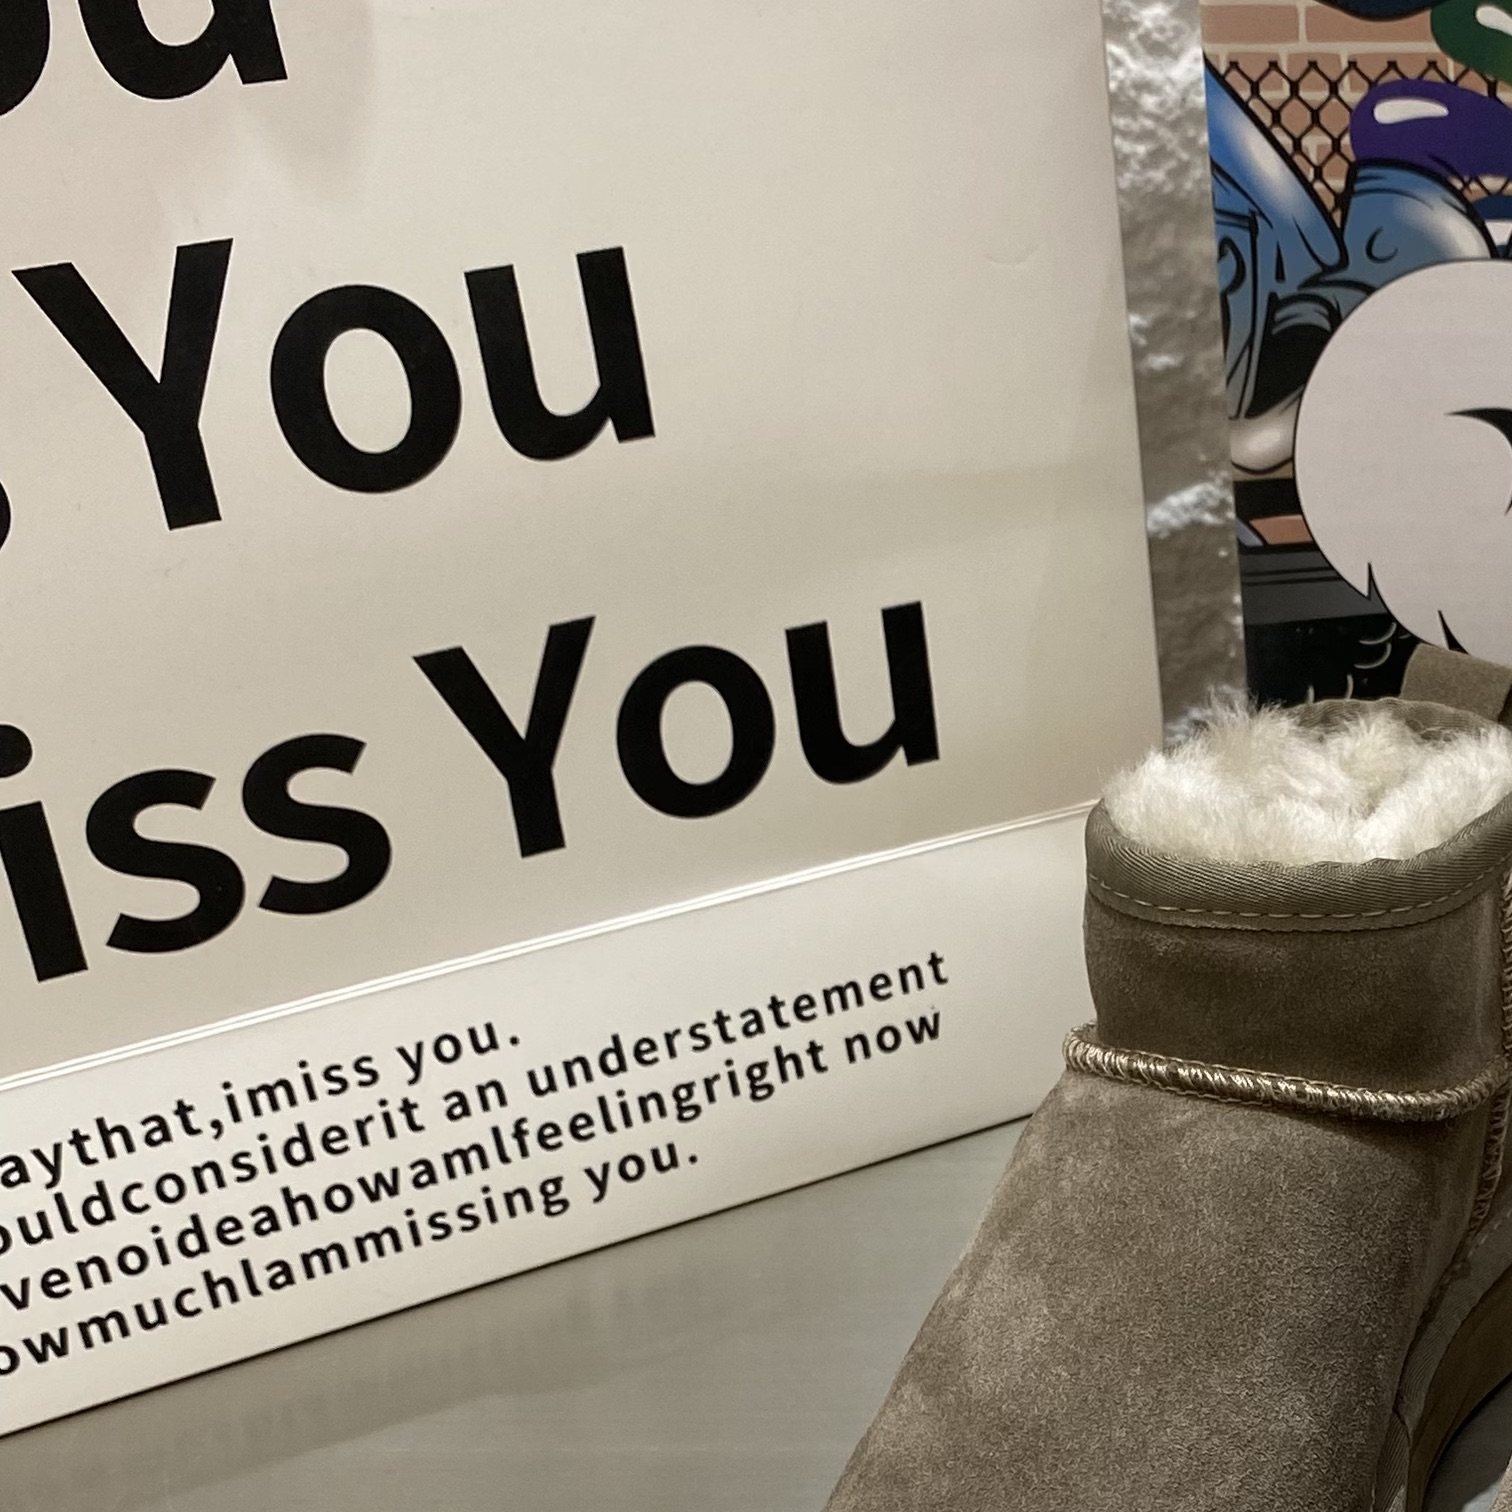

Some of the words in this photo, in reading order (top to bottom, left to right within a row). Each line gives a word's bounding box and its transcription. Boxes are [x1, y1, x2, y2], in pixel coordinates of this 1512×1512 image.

[12, 238, 655, 531] You
[413, 601, 940, 858] You
[397, 1021, 521, 1085] you.
[443, 1079, 508, 1122] an
[526, 951, 949, 1098] understatement
[843, 1011, 942, 1065] now
[584, 1141, 699, 1204] you.
